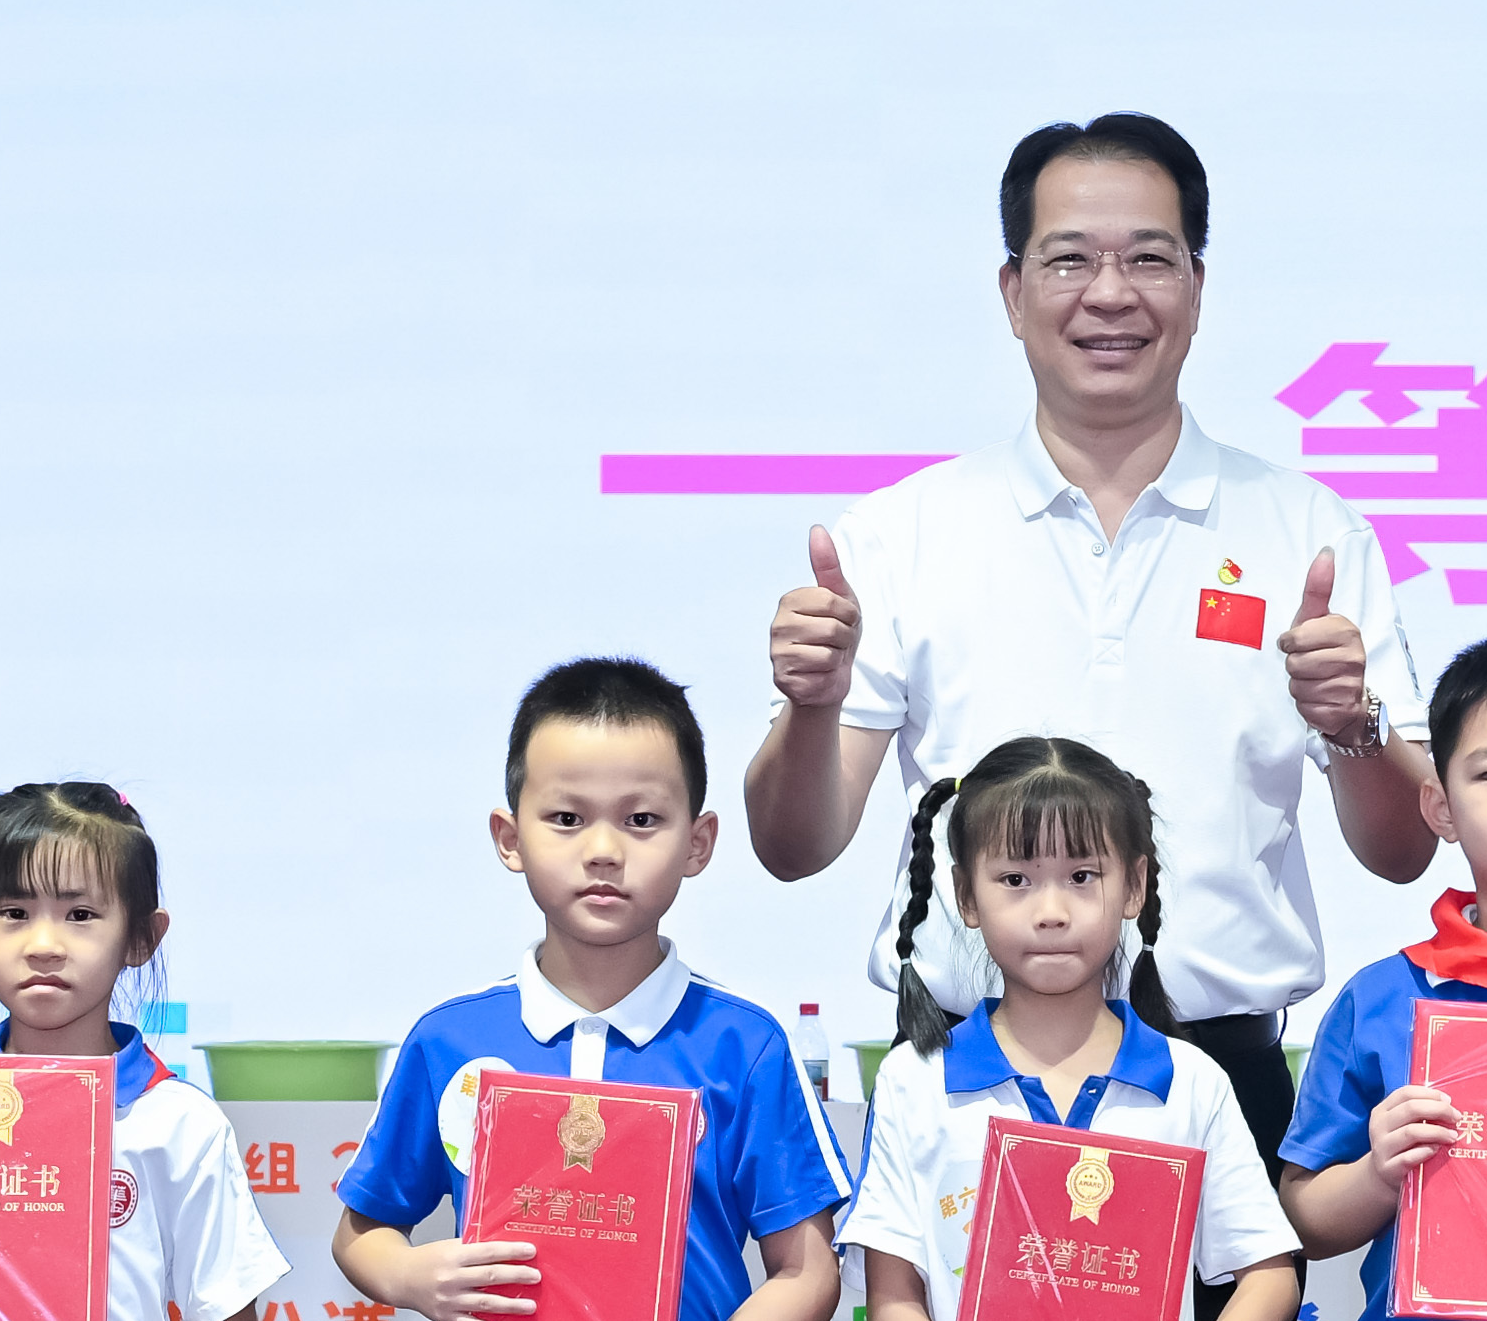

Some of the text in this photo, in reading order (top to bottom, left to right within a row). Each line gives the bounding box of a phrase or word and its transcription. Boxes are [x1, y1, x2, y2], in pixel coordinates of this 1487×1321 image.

[5, 1202, 19, 1212] OF
[24, 1202, 65, 1212] HONOR
[511, 1184, 636, 1226] 荣誉证书
[504, 1222, 638, 1243] CERTIFICATE OF HONOR
[1016, 1233, 1141, 1280] 荣誉证书
[1008, 1269, 1141, 1296] CERTIFICATE OF HONOR
